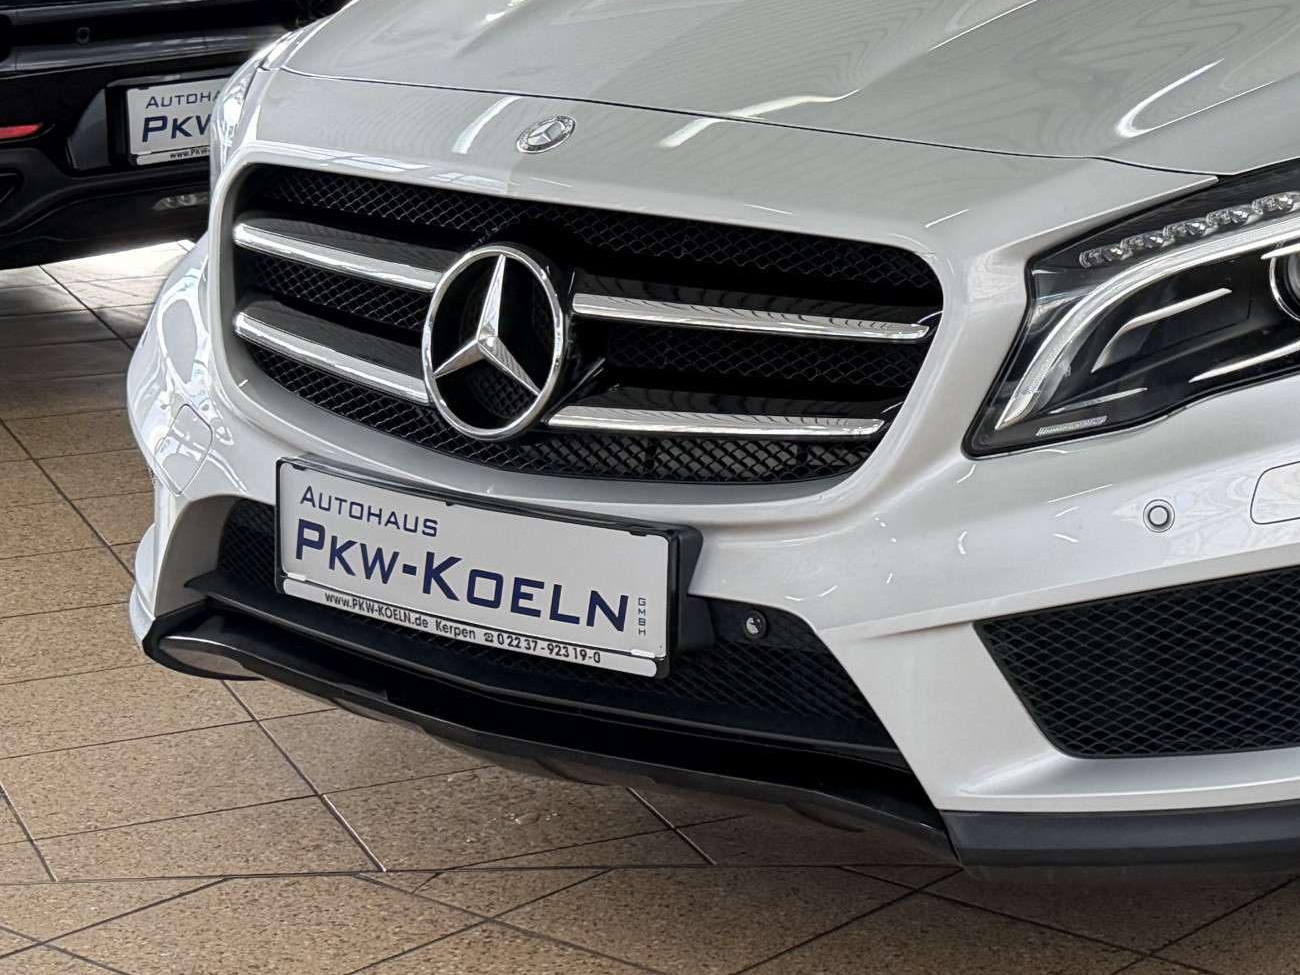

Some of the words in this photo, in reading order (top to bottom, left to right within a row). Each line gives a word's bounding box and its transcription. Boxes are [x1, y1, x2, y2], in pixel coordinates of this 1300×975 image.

[300, 485, 439, 538] AUTOHAUS
[295, 518, 629, 633] PKW-KOELN
[324, 592, 429, 629] www.PKW-KOELN.de
[435, 619, 476, 640] Kerpen
